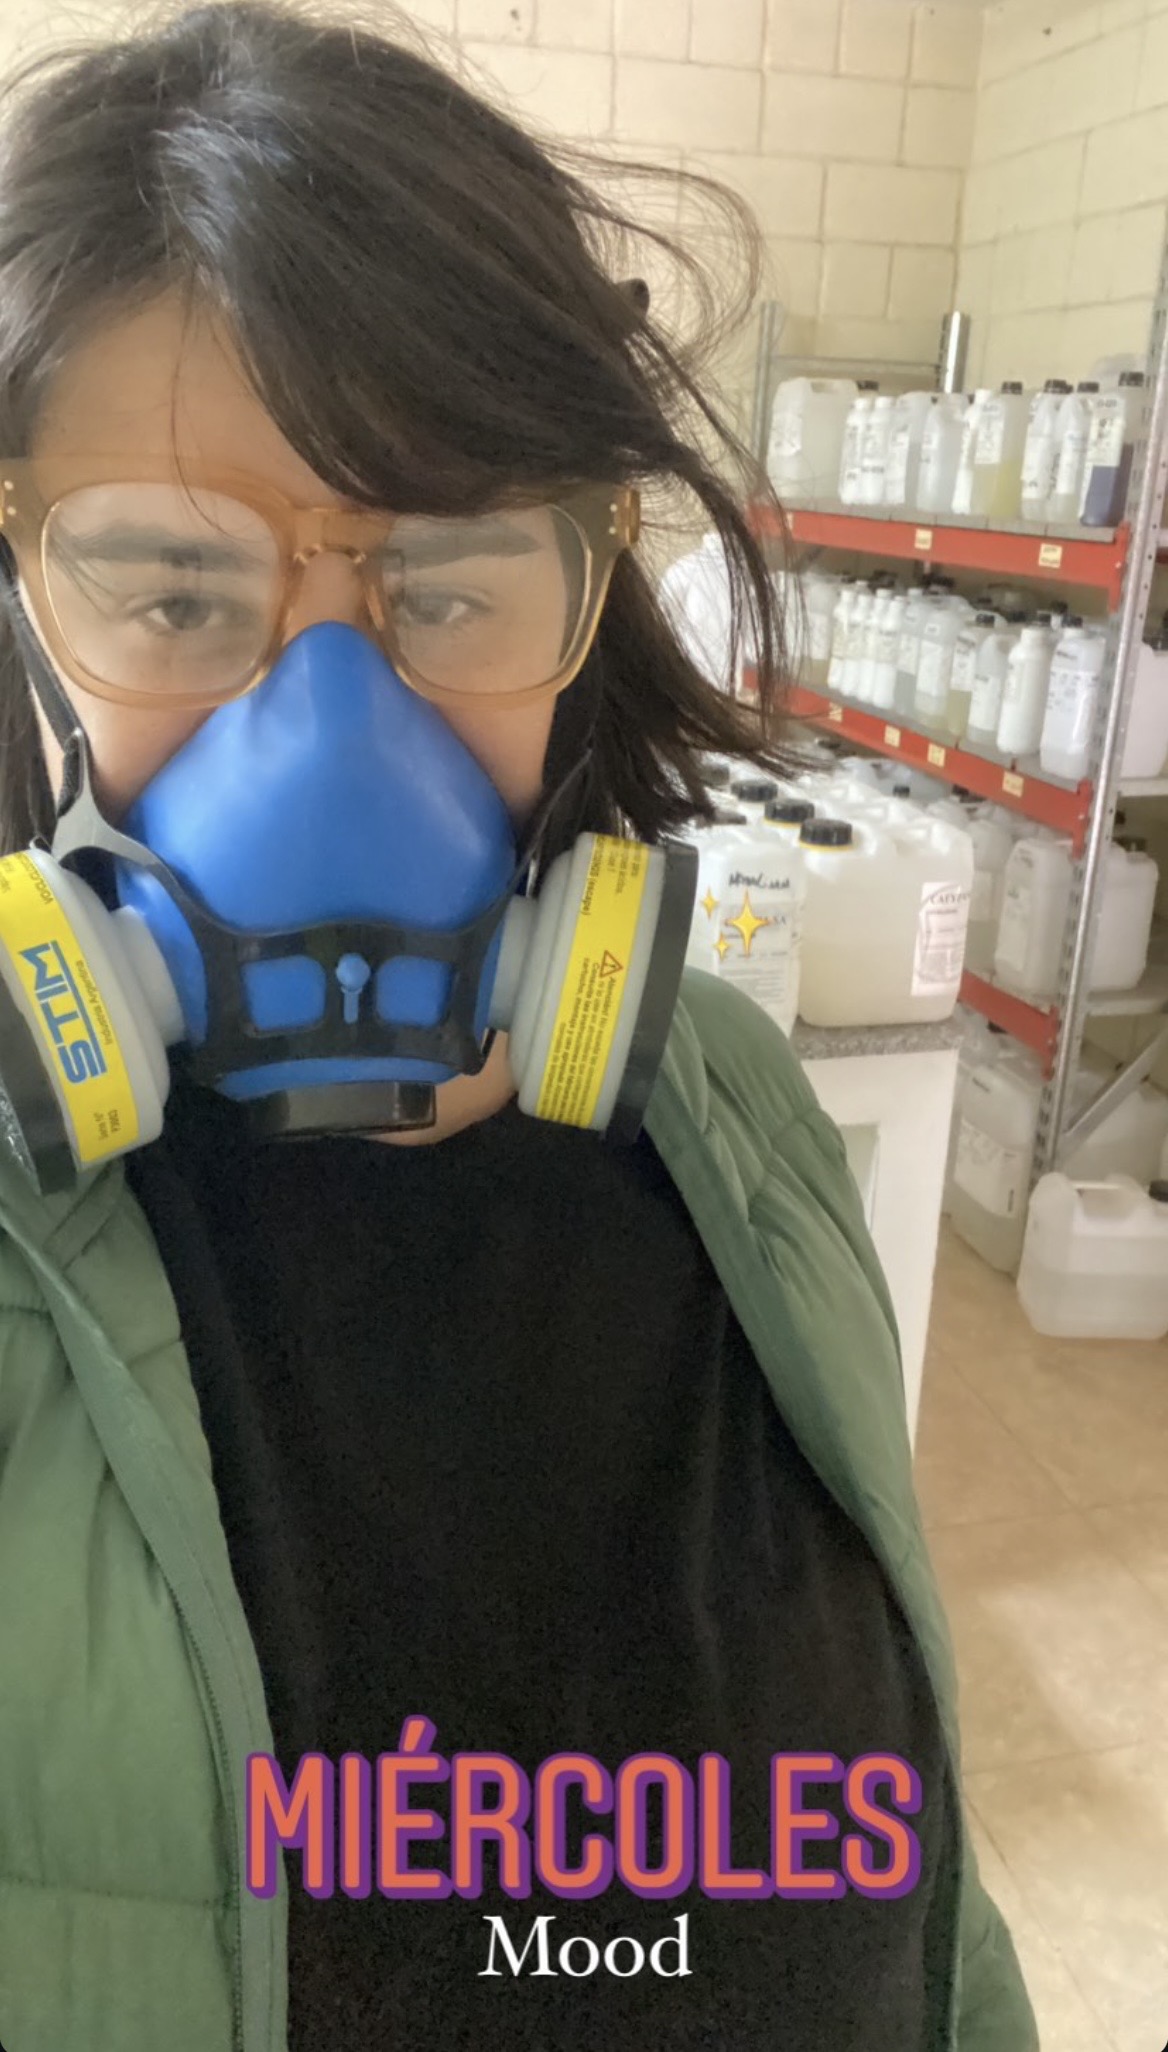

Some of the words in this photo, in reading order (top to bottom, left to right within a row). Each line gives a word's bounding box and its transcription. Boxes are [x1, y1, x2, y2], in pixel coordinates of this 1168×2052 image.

[581, 878, 597, 915] (escape)
[74, 959, 97, 1004] Argentina
[17, 940, 105, 1084] STIM
[92, 1004, 113, 1045] Industria
